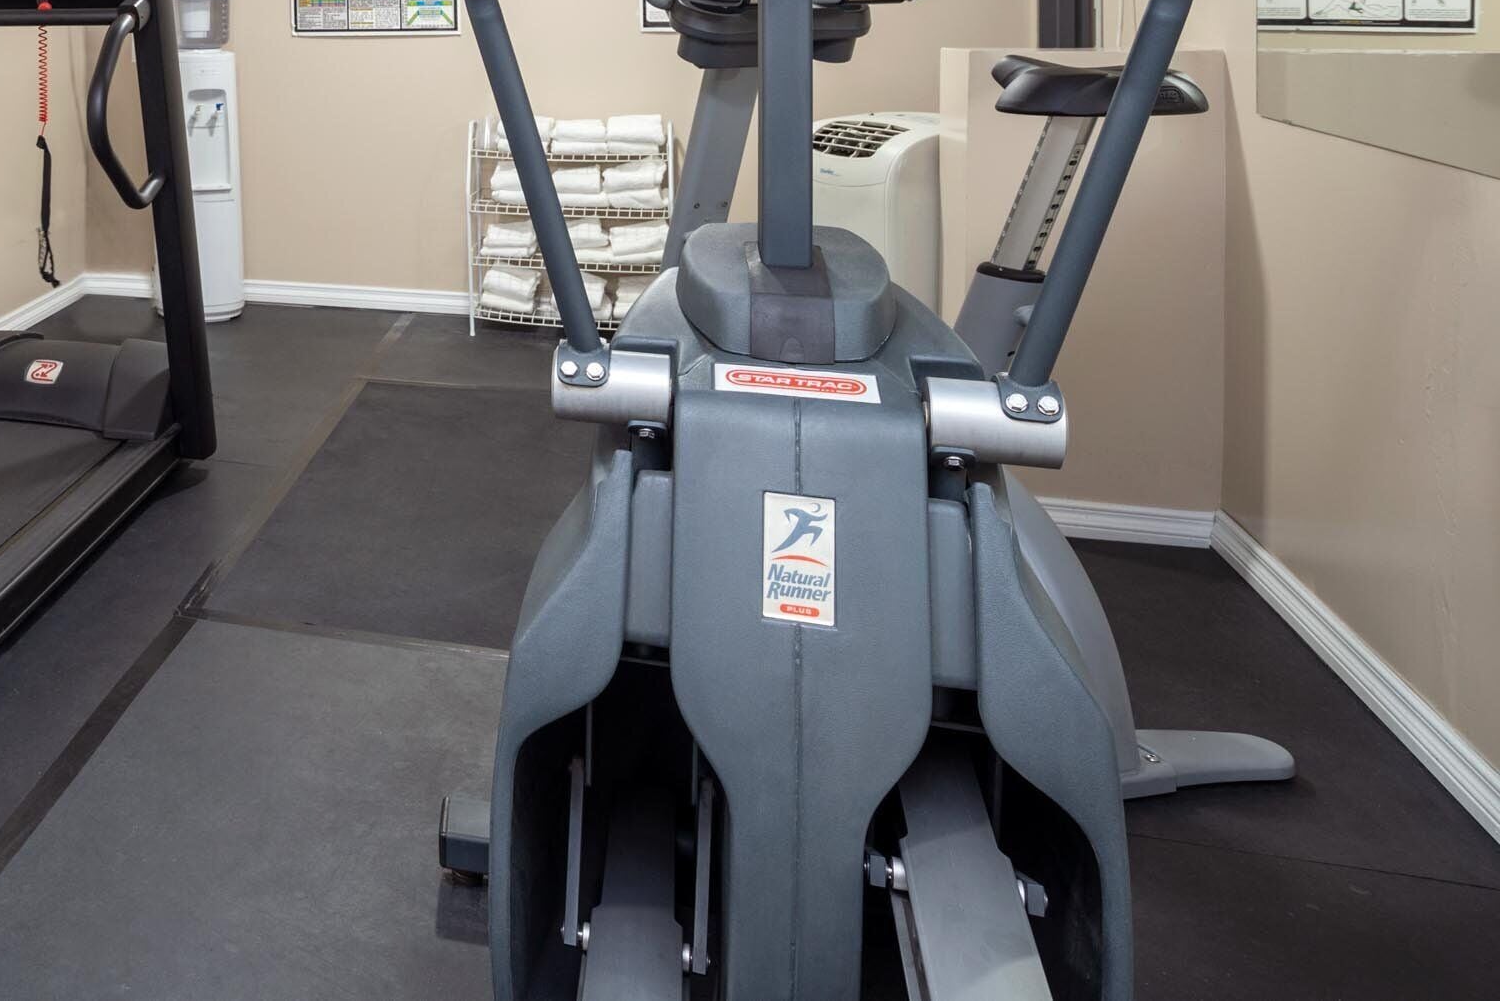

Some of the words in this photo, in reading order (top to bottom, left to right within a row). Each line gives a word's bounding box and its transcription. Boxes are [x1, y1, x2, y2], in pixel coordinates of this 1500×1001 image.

[738, 374, 791, 386] STAR
[795, 379, 854, 390] TRAC
[767, 563, 831, 588] Natural
[767, 581, 831, 602] Runner
[786, 605, 812, 615] PLUS
